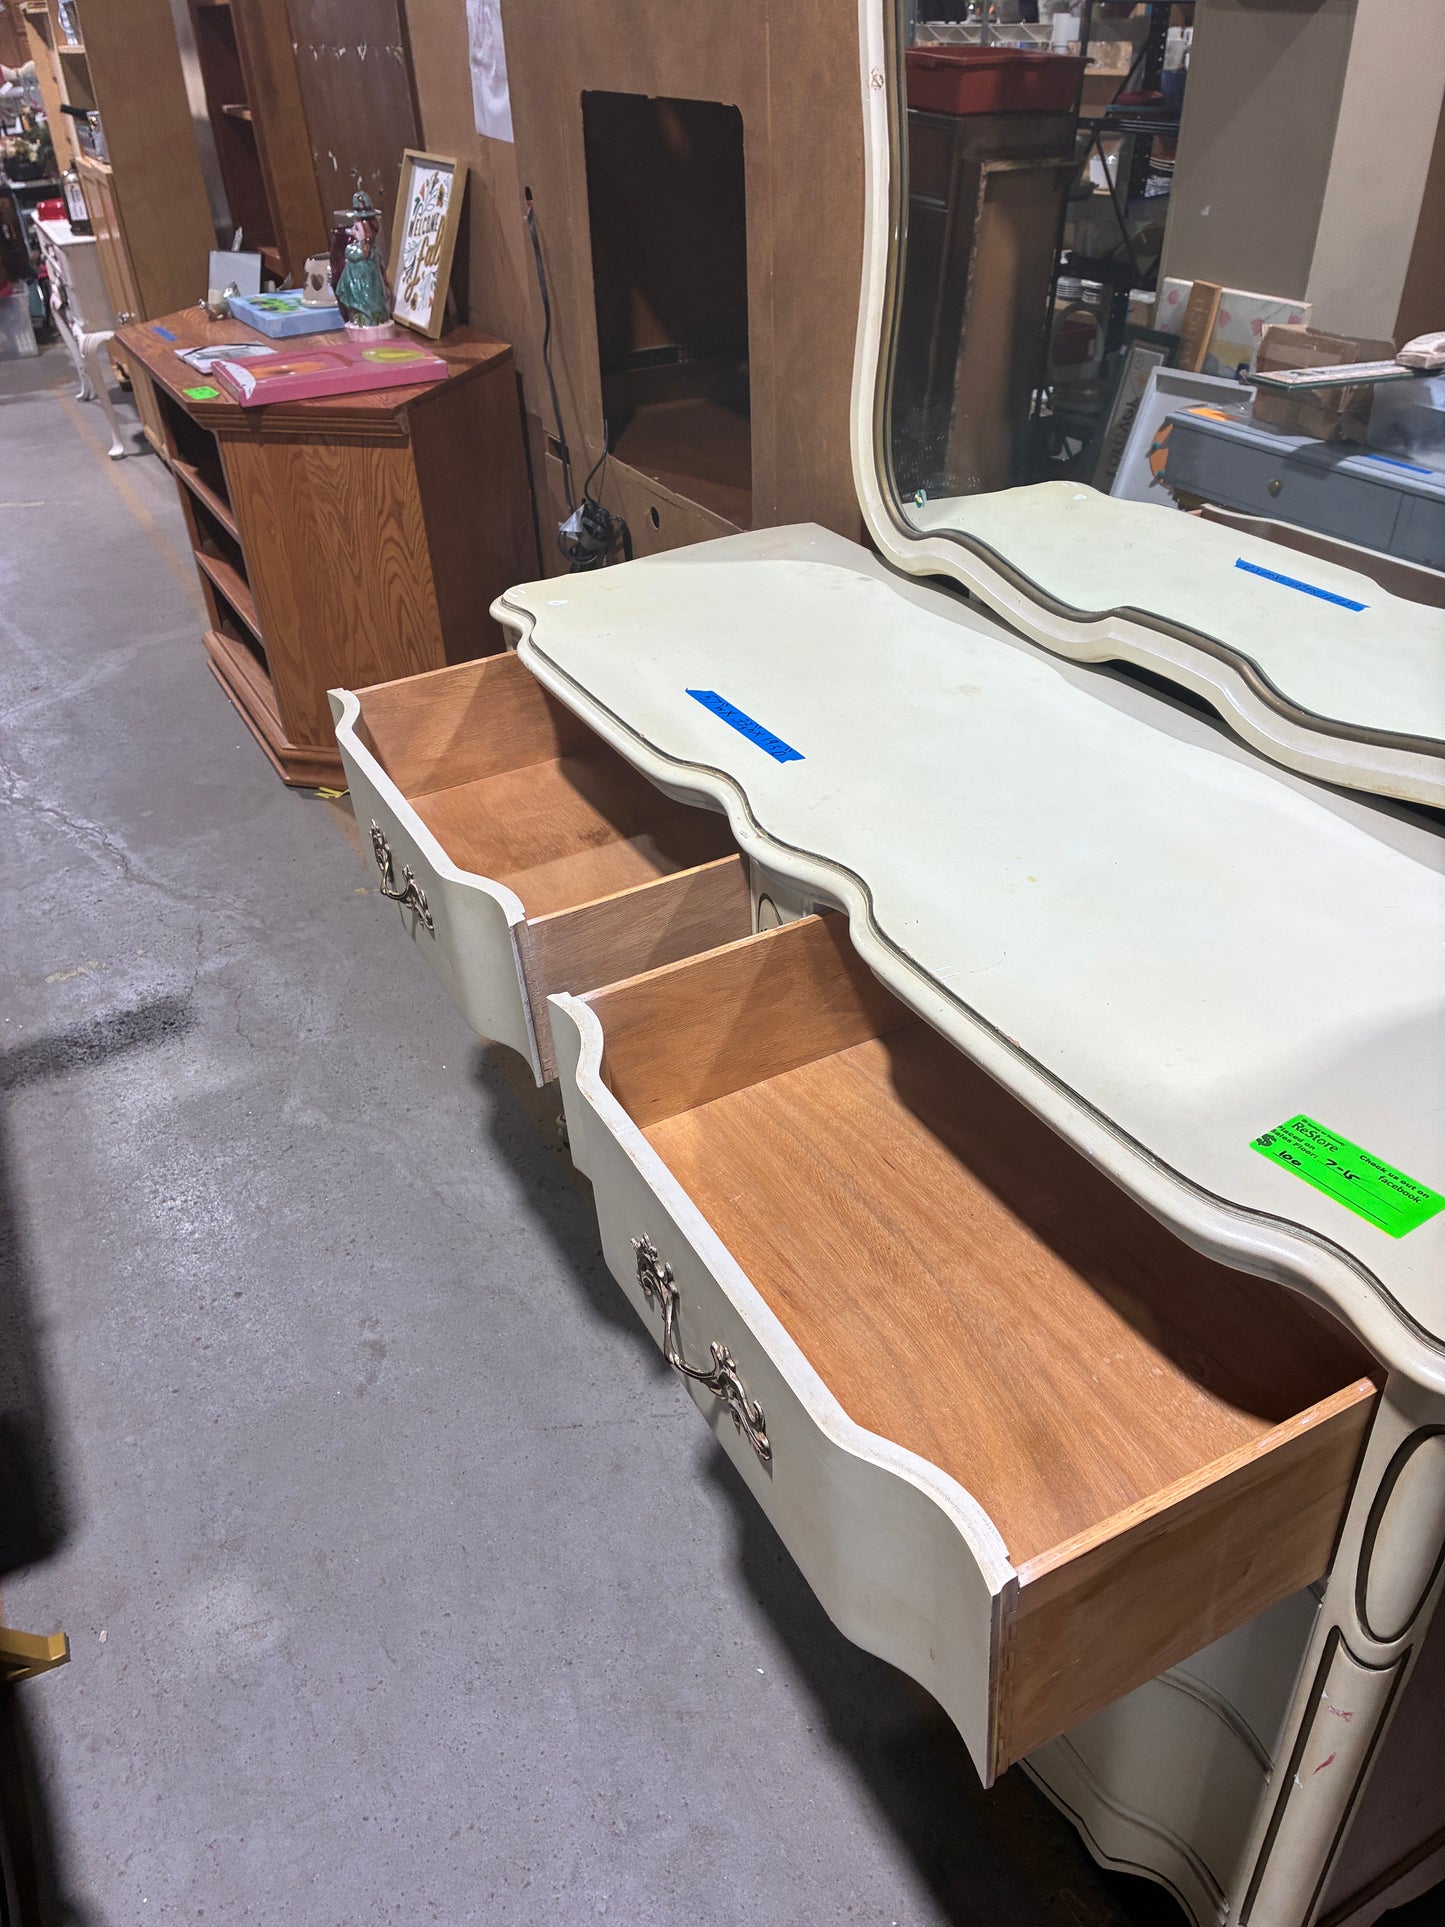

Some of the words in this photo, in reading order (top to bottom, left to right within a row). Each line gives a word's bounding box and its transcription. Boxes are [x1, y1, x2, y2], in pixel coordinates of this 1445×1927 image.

[408, 212, 440, 238] WELCOME
[1291, 1121, 1339, 1153] ReStore
[1304, 1142, 1316, 1151] on
[1278, 1150, 1302, 1166] 100
[1325, 1158, 1361, 1180] 7-15
[1359, 1154, 1387, 1173] Check
[1388, 1172, 1399, 1180] us
[1400, 1180, 1416, 1190] out
[1417, 1190, 1430, 1198] on
[1378, 1175, 1421, 1203] facebook
